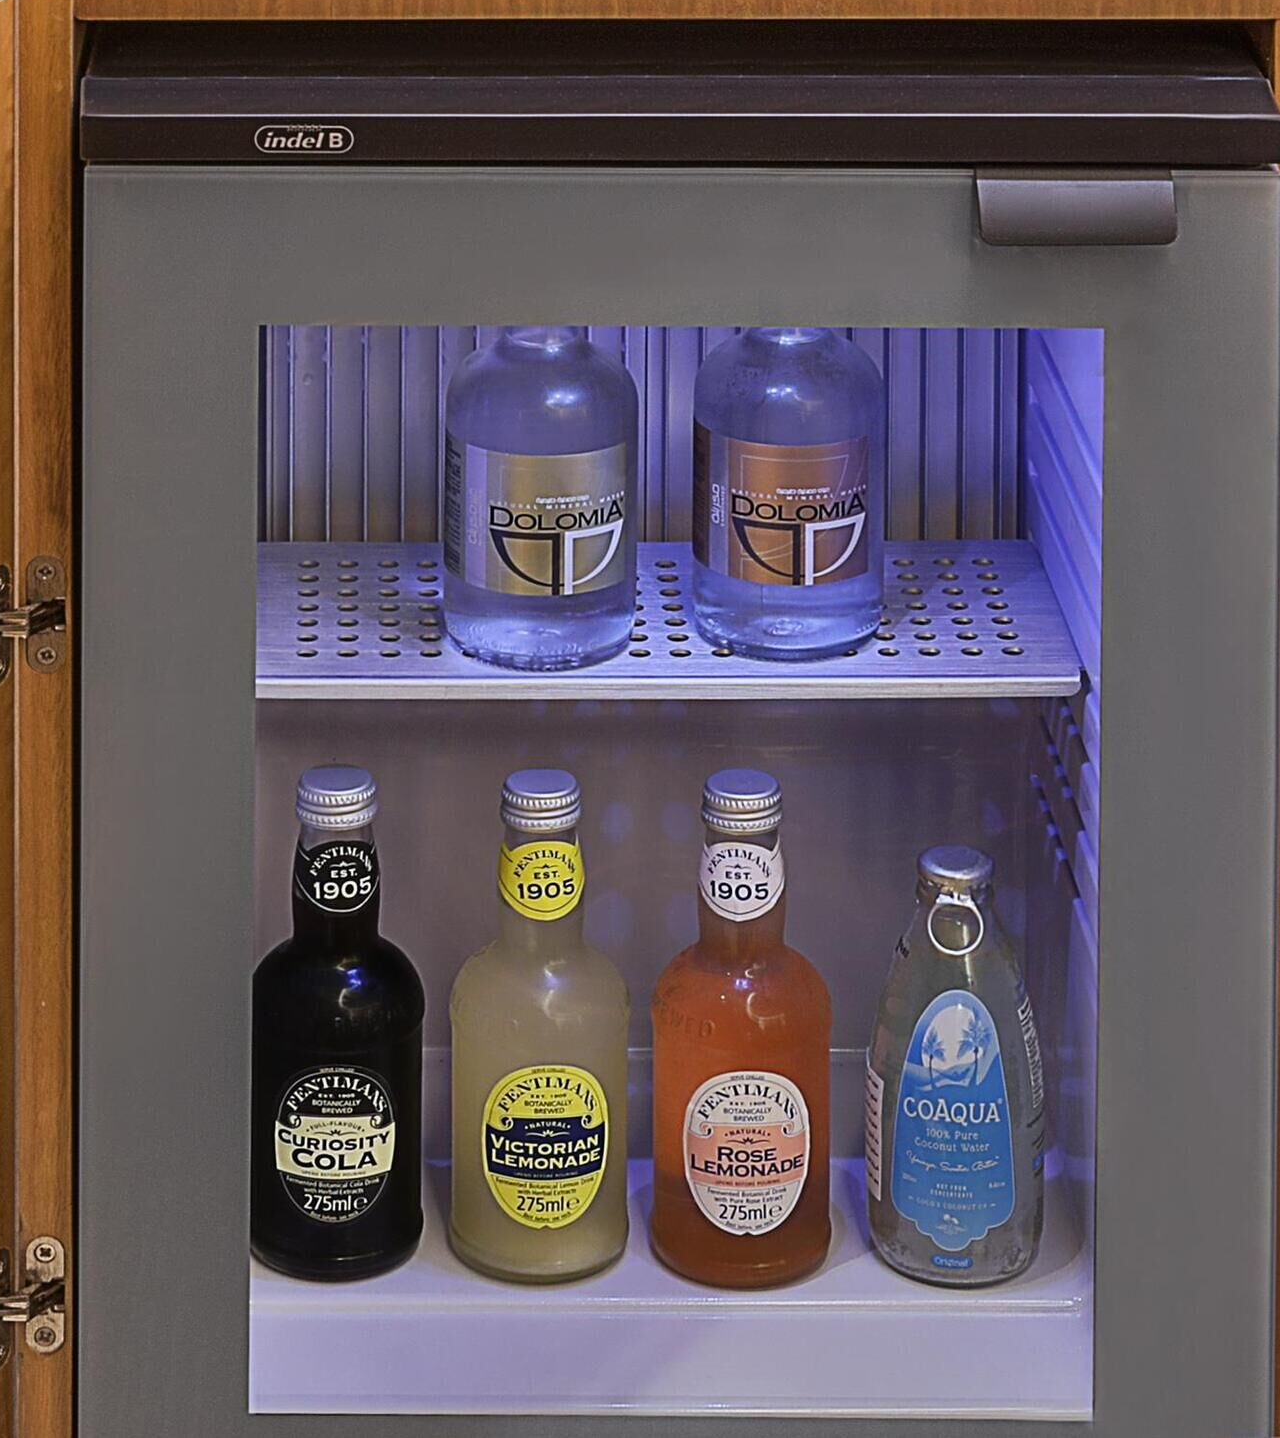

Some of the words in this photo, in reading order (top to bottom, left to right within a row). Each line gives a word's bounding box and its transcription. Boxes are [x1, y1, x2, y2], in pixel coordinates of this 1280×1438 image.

[264, 132, 324, 149] indel
[329, 133, 343, 148] B
[489, 500, 623, 530] DOLOMIA
[731, 492, 865, 522] DOLOMIA
[310, 846, 372, 876] FENTIMANS
[513, 850, 576, 878] FENTIMANS
[707, 848, 772, 878] FENTIMANS
[330, 868, 358, 878] EST.
[533, 870, 560, 880] EST.
[725, 871, 752, 880] EST.
[313, 876, 371, 900] 1905
[517, 878, 575, 900] 1905
[710, 880, 769, 901] 1905
[287, 1076, 388, 1113] FENTIMANS
[498, 1076, 597, 1112] FENTIMANS
[697, 1084, 798, 1120] FENTIMANS
[903, 1097, 1001, 1126] COAQUA
[277, 1129, 390, 1151] CURIOSITY
[490, 1133, 599, 1156] VICTORIAN
[914, 1137, 957, 1152] Coconut
[961, 1142, 990, 1152] Water
[926, 1128, 950, 1139] 100%
[954, 1130, 979, 1140] Pure
[292, 1148, 378, 1171] COLA
[491, 1148, 601, 1170] LEMONADE
[717, 1145, 777, 1163] ROSE
[690, 1153, 804, 1178] LEMONADE
[304, 1194, 352, 1211] 275ml
[517, 1196, 564, 1212] 275ml
[719, 1204, 766, 1220] 275ml
